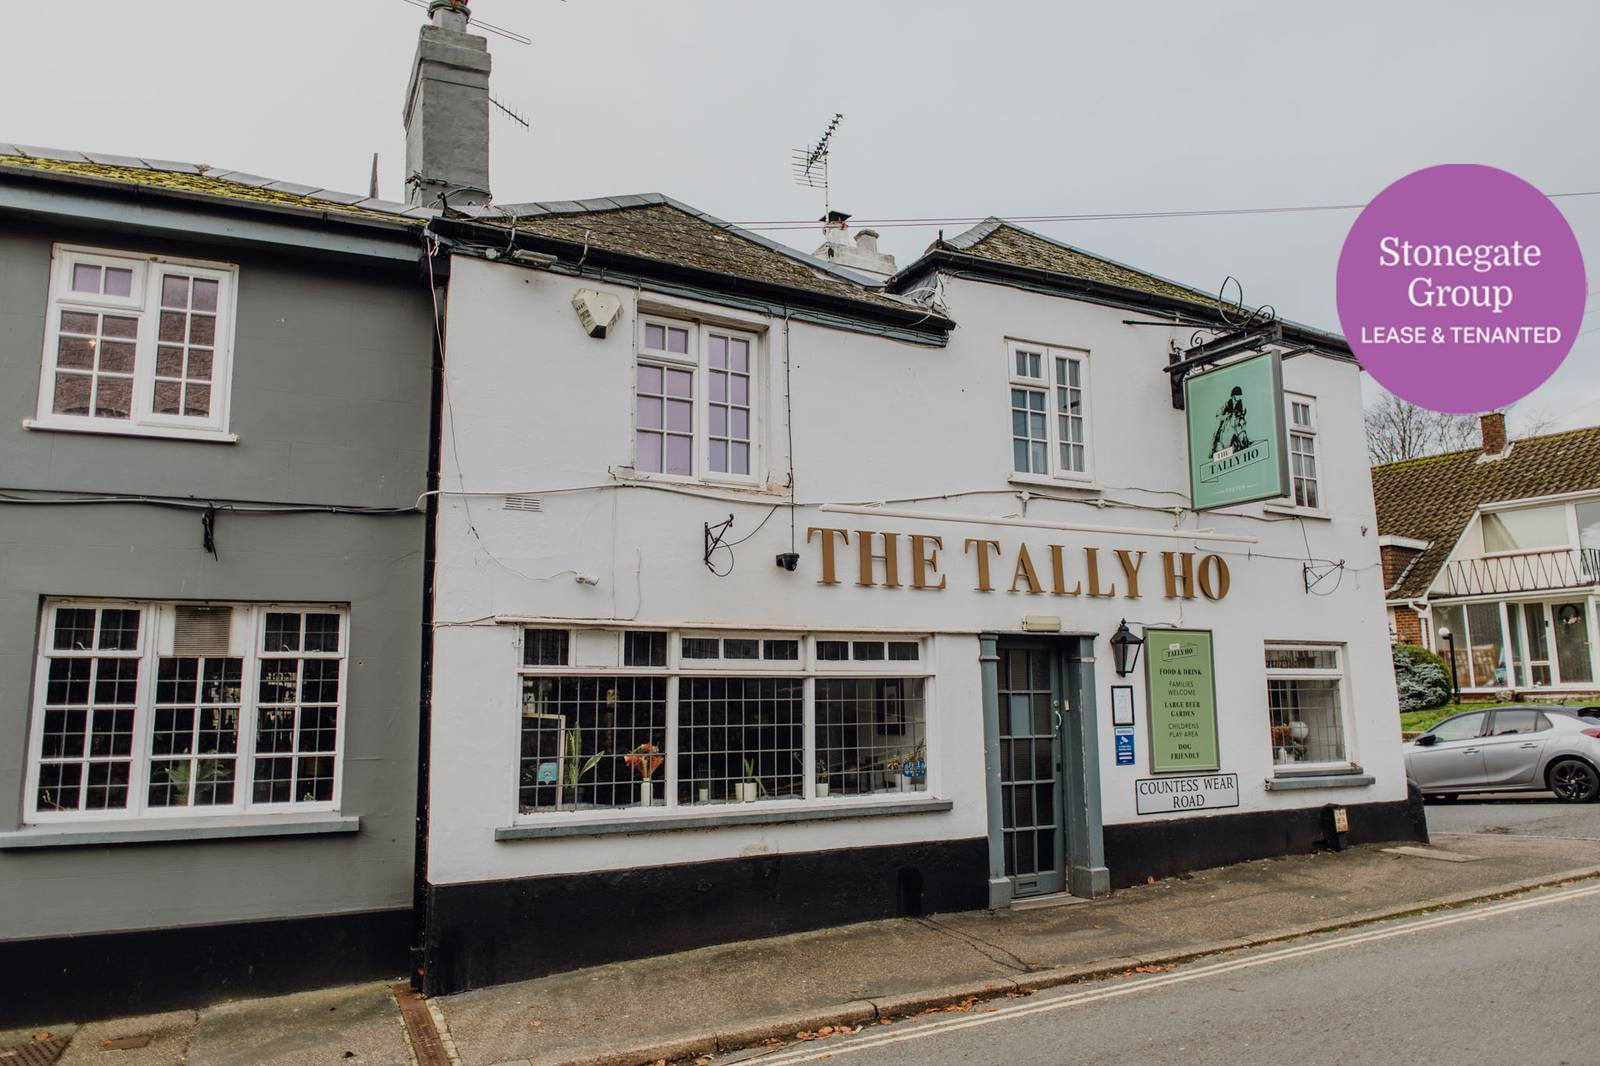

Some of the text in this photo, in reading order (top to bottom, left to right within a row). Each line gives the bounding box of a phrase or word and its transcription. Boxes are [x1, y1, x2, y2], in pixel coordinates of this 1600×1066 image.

[1210, 448, 1259, 475] TALLY HO
[807, 526, 1231, 601] THE TALLY HO
[1159, 668, 1176, 676] FOOD
[1183, 668, 1202, 676] DRINK
[1168, 680, 1194, 688] FAMILIES
[1168, 688, 1196, 696] WELCOME
[1164, 701, 1184, 709] LARGE
[1184, 730, 1199, 738] AREA
[1170, 752, 1200, 760] FRIENDLY
[1139, 776, 1234, 796] COUNTESS WEAR
[1173, 794, 1205, 809] ROAD
